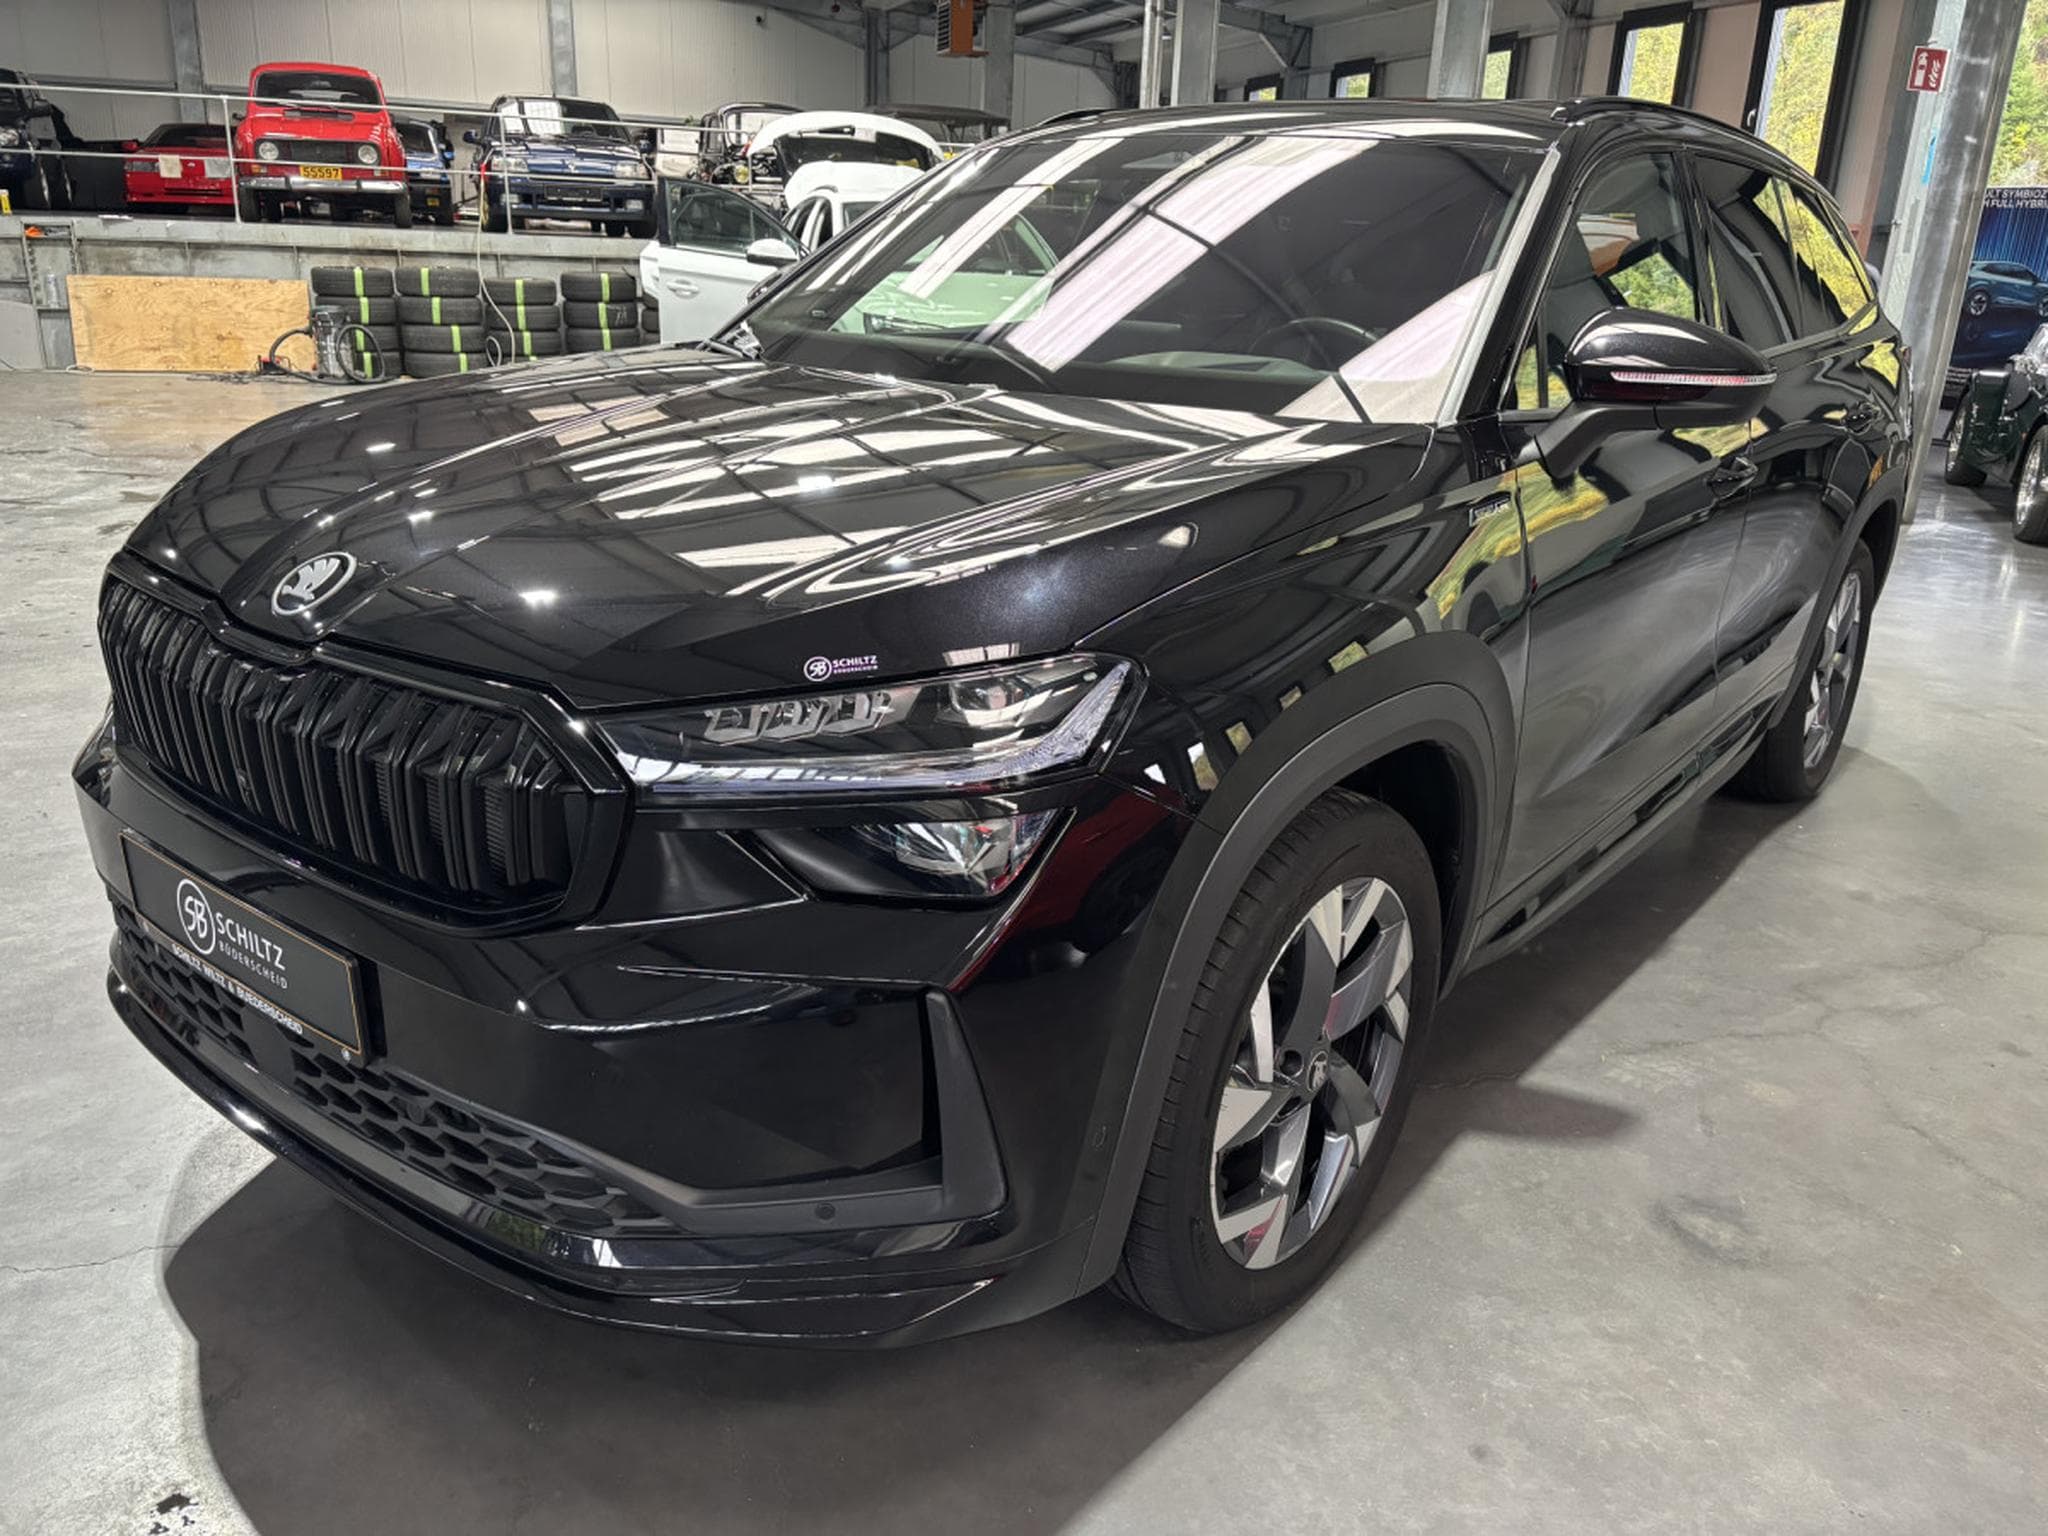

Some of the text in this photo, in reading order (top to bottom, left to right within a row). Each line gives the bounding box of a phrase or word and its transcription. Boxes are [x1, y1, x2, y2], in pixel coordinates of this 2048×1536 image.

[303, 166, 339, 178] 55597
[2001, 189, 2048, 199] SYMBIOZ
[1990, 199, 2014, 208] FULL
[832, 655, 878, 668] SCHILTZ
[215, 912, 286, 971] SCHILTZ
